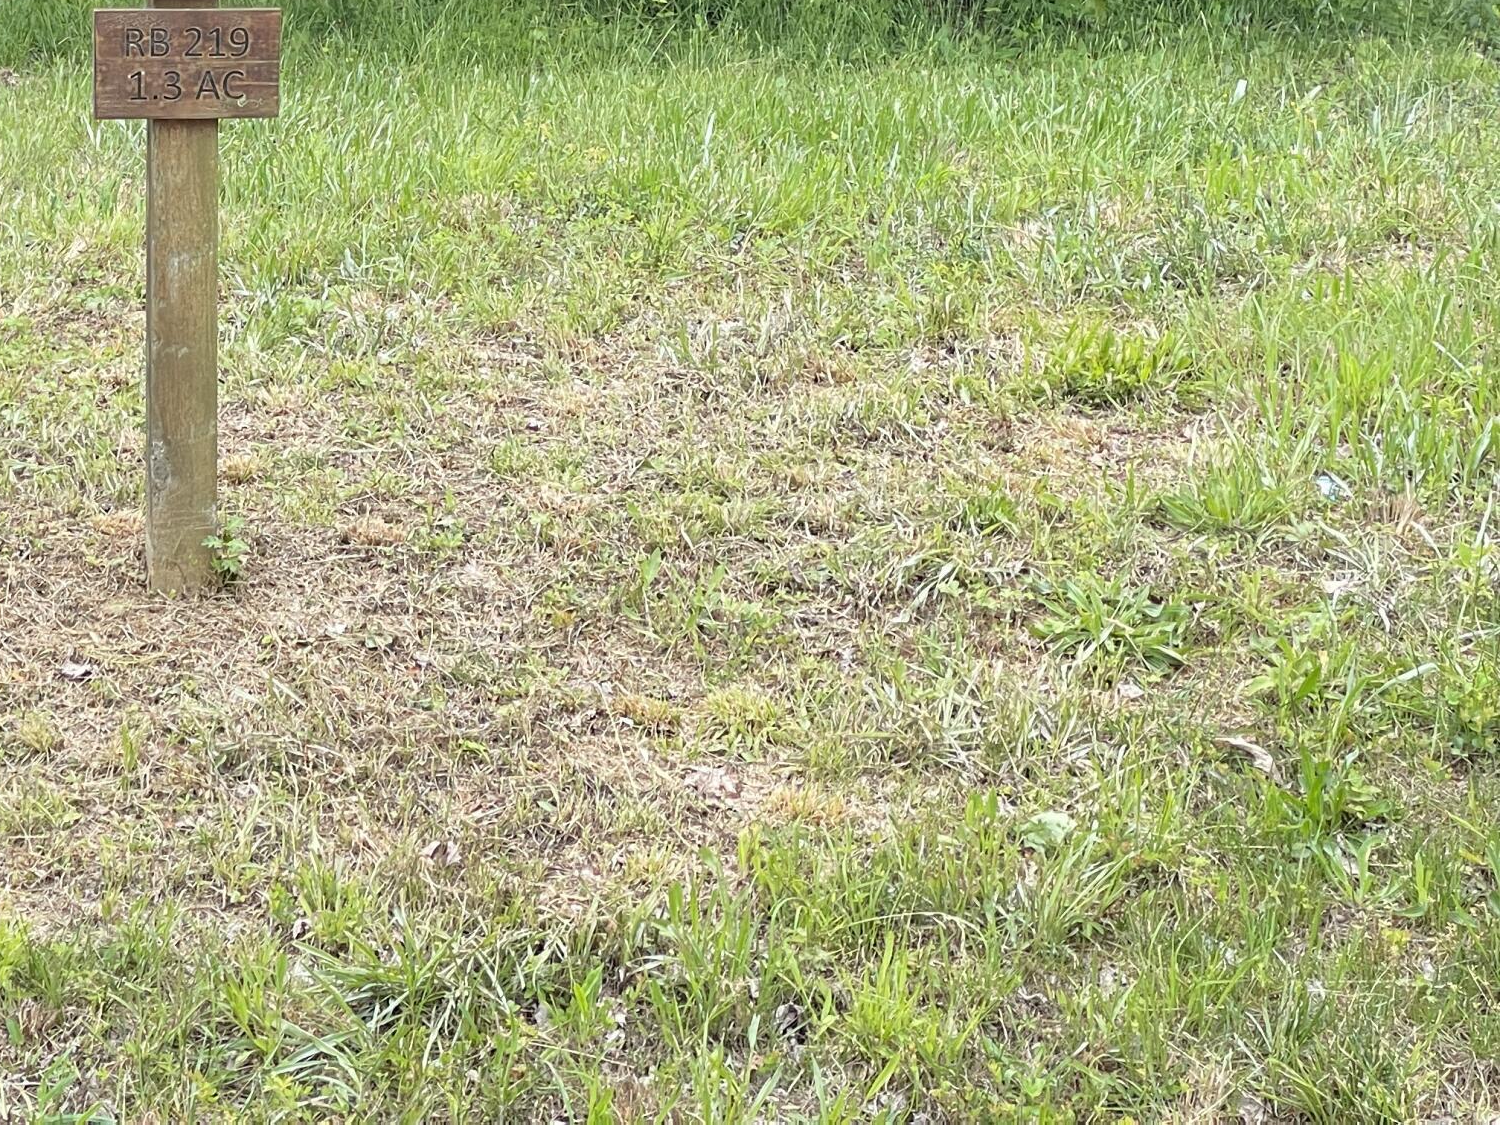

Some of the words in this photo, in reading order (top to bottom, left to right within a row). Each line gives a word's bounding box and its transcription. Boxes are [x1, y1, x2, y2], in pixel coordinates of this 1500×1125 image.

[124, 28, 170, 58] RB
[184, 27, 250, 58] 219
[129, 70, 183, 101] 1.3
[195, 70, 246, 101] AC
